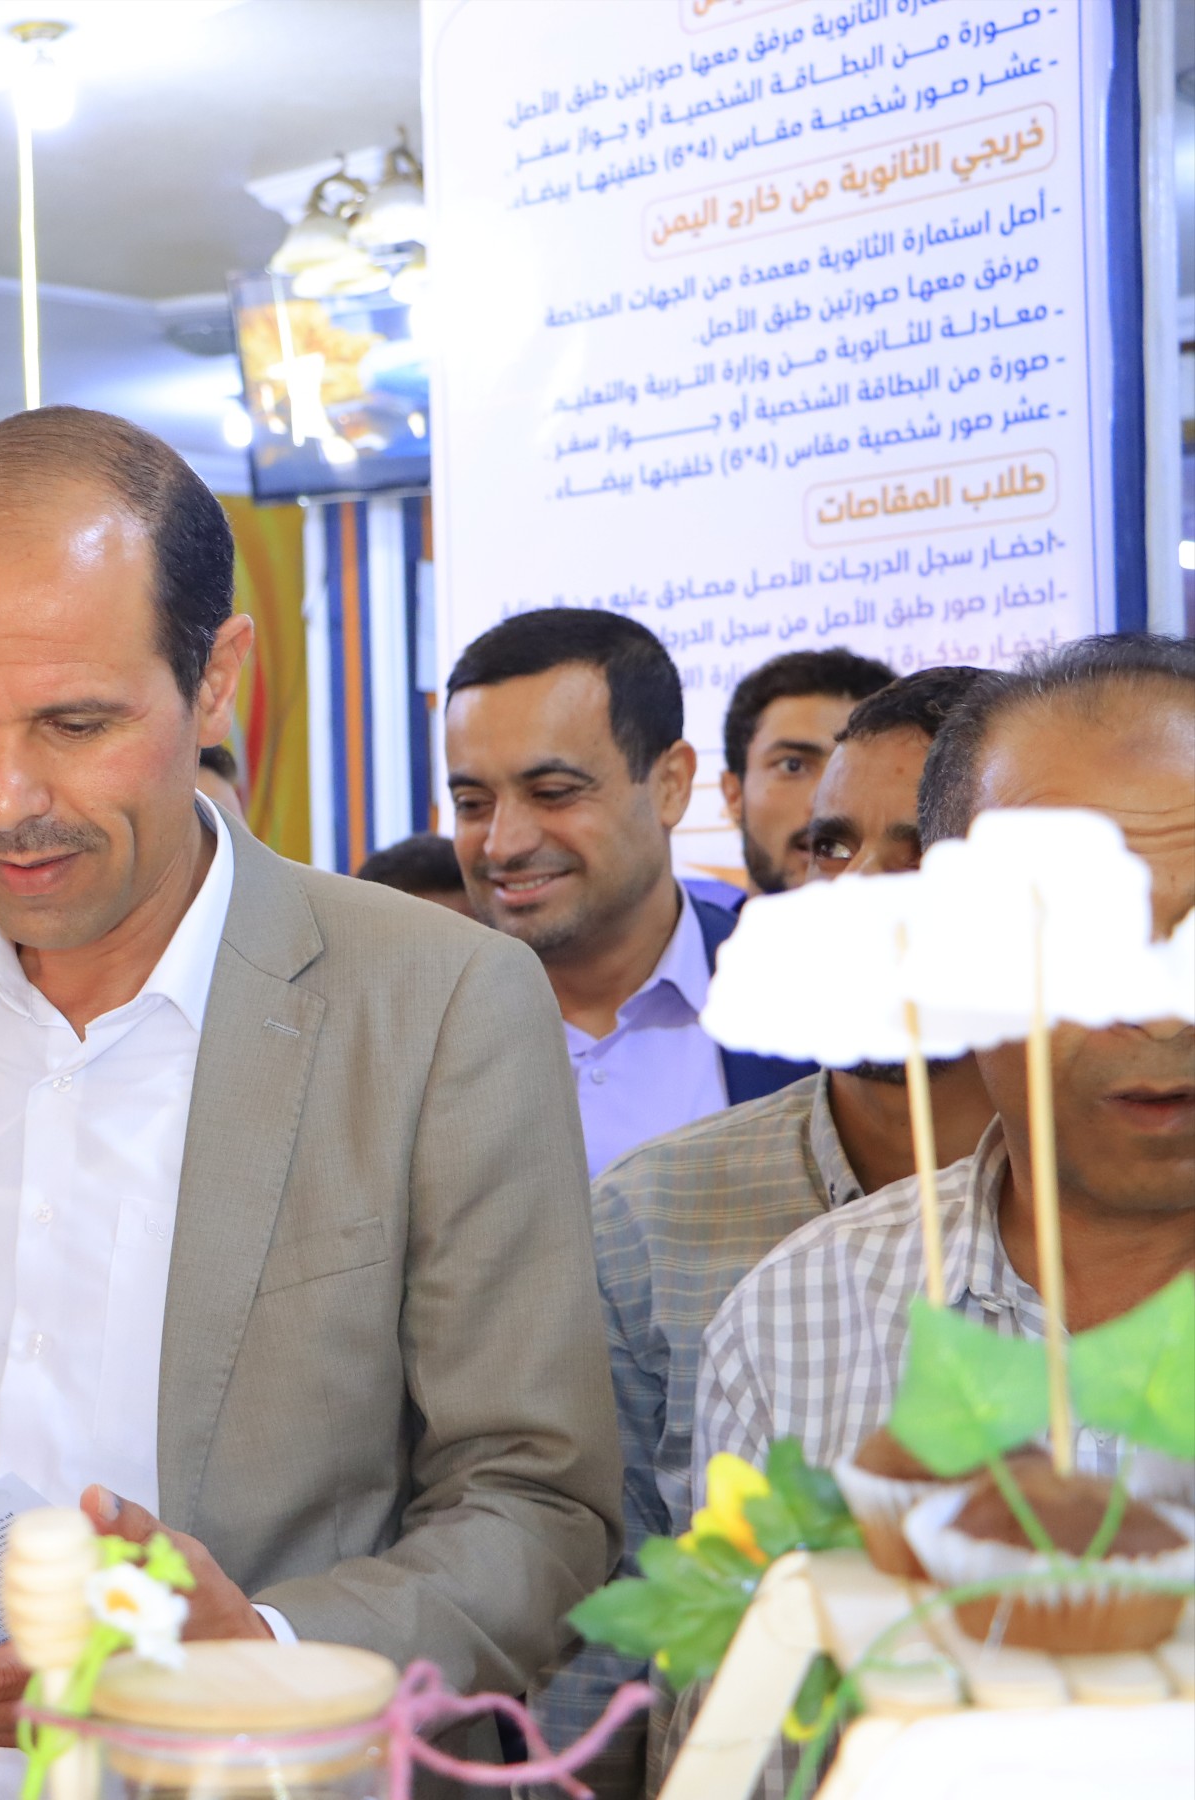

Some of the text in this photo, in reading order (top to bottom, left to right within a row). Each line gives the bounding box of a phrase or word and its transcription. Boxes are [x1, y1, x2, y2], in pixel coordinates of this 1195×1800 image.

[914, 76, 970, 112] صور
[651, 116, 1045, 247] خريجي الثانوية من خارج اليمن
[902, 208, 991, 256] استمارة
[818, 230, 896, 274] الثانوية
[703, 275, 733, 302] من
[906, 272, 966, 303] معها
[973, 254, 1040, 291] مرفق
[762, 297, 812, 335] طبق
[818, 284, 900, 324] صورتين
[834, 318, 933, 365] للثانوية
[721, 353, 770, 387] وزارة
[776, 346, 828, 378] من
[947, 365, 981, 395] من
[989, 352, 1050, 384] صورة
[857, 365, 940, 402] البطاقة
[754, 381, 851, 426] الشخصية
[1000, 394, 1051, 433] عشر
[857, 411, 943, 455] شخصية
[948, 411, 994, 443] صور
[784, 432, 851, 469] مقاس
[638, 451, 714, 490] خلفيتها
[816, 462, 1046, 526] طلاب المقاصات
[817, 547, 911, 586] الدرجات
[916, 545, 974, 578] سجل
[815, 597, 876, 637] الأصل
[882, 594, 935, 630] طبق
[941, 593, 987, 623] صور
[777, 616, 808, 642] من
